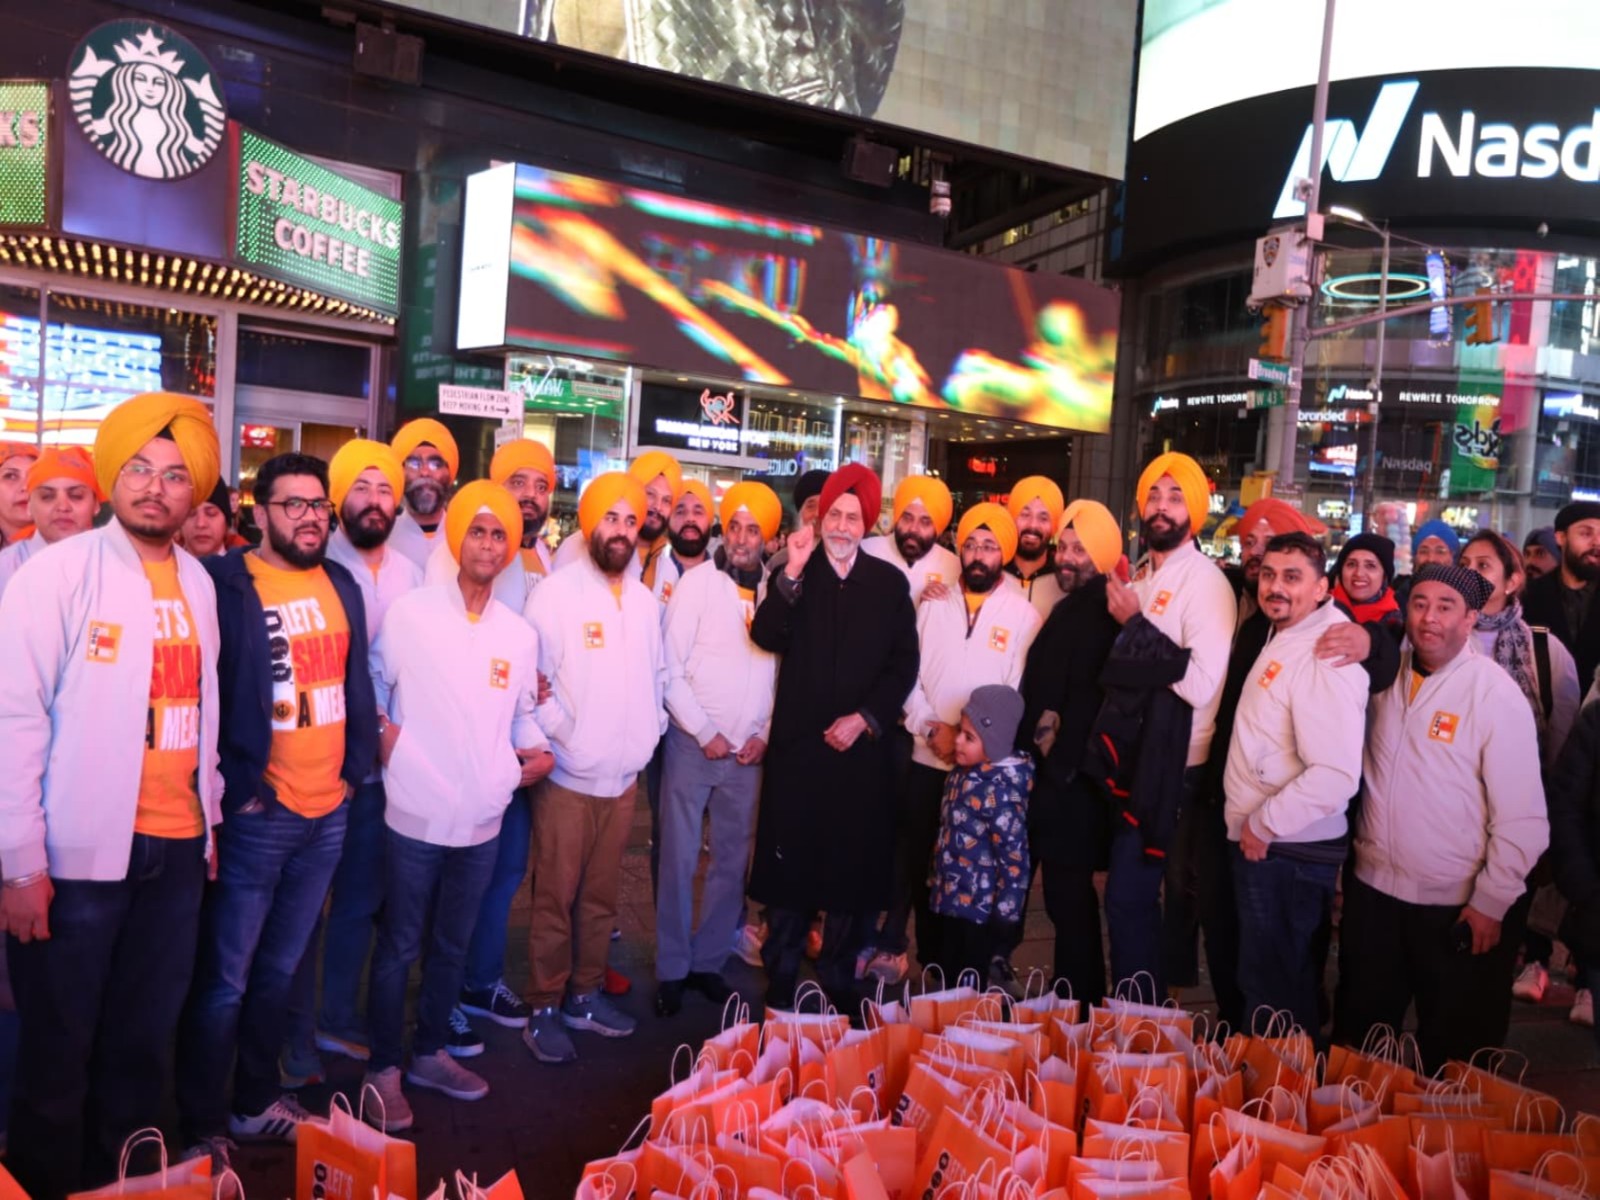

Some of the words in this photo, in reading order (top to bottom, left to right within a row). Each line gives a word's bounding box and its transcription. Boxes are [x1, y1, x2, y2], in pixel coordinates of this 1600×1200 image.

[246, 160, 400, 250] STARBUCKS
[274, 217, 371, 278] COFFEE
[1258, 363, 1288, 385] Broadway
[1399, 391, 1443, 404] REWRITE
[1446, 394, 1500, 406] TOMORROW
[689, 439, 711, 448] NEW
[713, 441, 737, 451] YORK
[1382, 457, 1433, 474] Nasdaq
[152, 599, 190, 639] ET'S
[281, 597, 327, 636] LET'S
[297, 691, 311, 728] A
